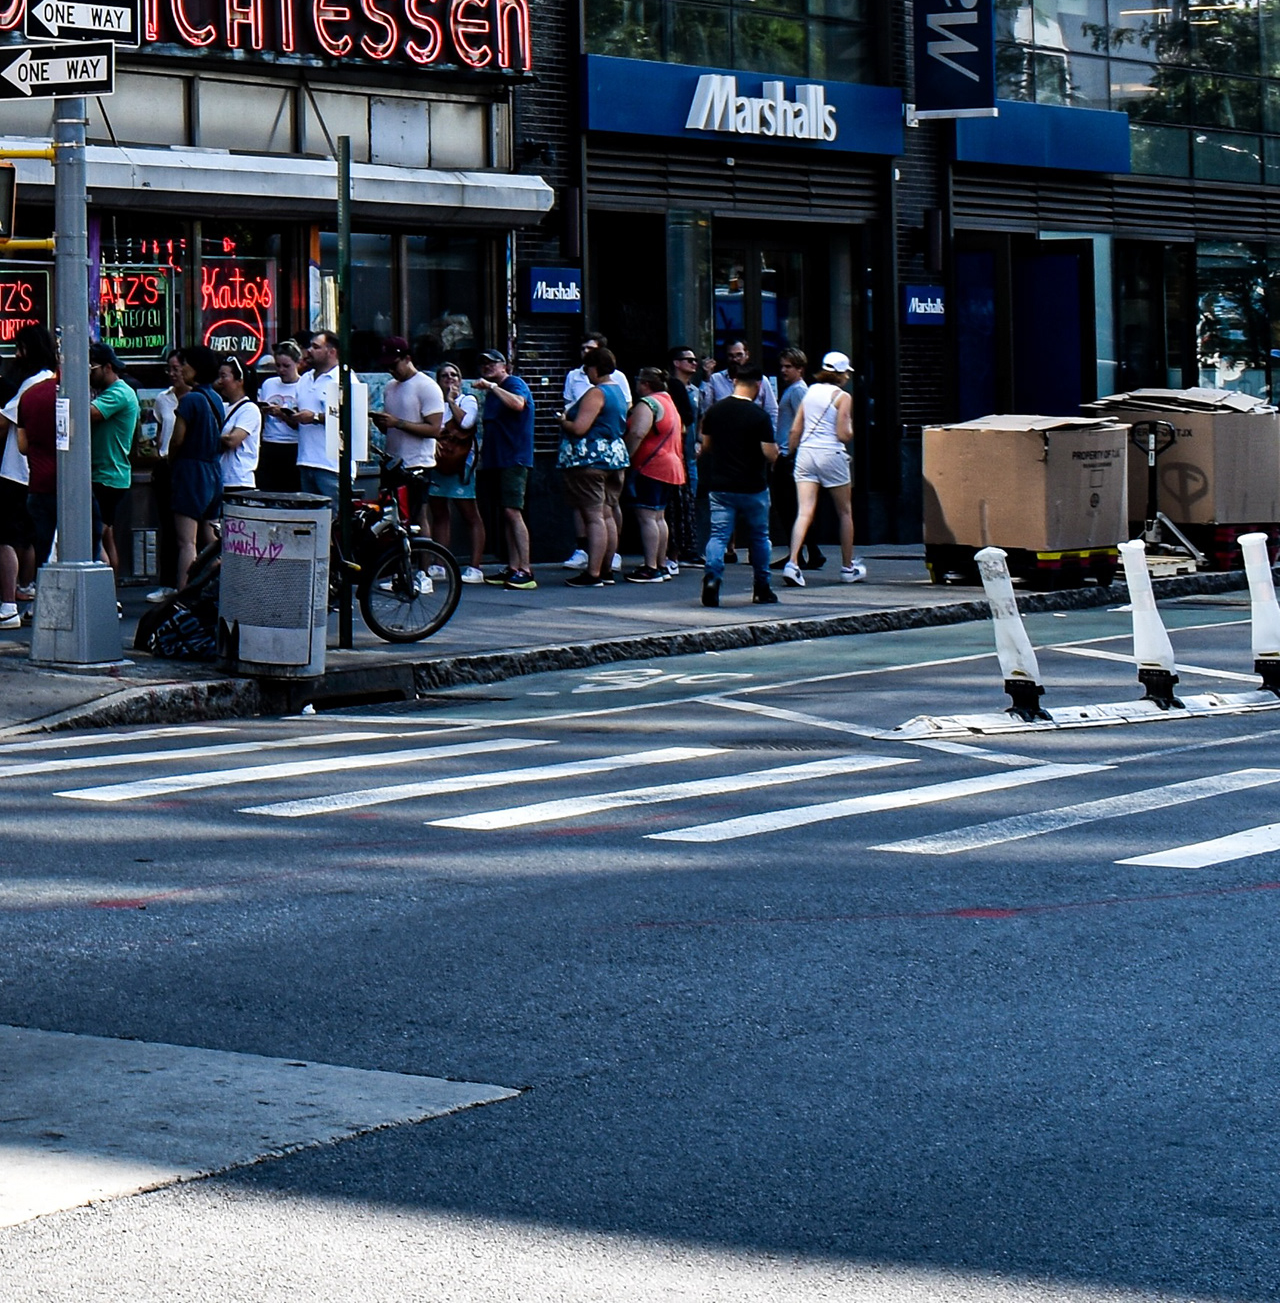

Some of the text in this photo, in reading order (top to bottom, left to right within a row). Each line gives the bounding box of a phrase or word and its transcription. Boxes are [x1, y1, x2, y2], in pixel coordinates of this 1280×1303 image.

[44, 3, 124, 30] ONE WAY
[18, 59, 101, 83] ONE WAY
[685, 74, 838, 142] Marshalls
[99, 274, 159, 305] ATZ'S
[533, 281, 581, 301] Marshalls
[909, 297, 945, 314] Marshalls
